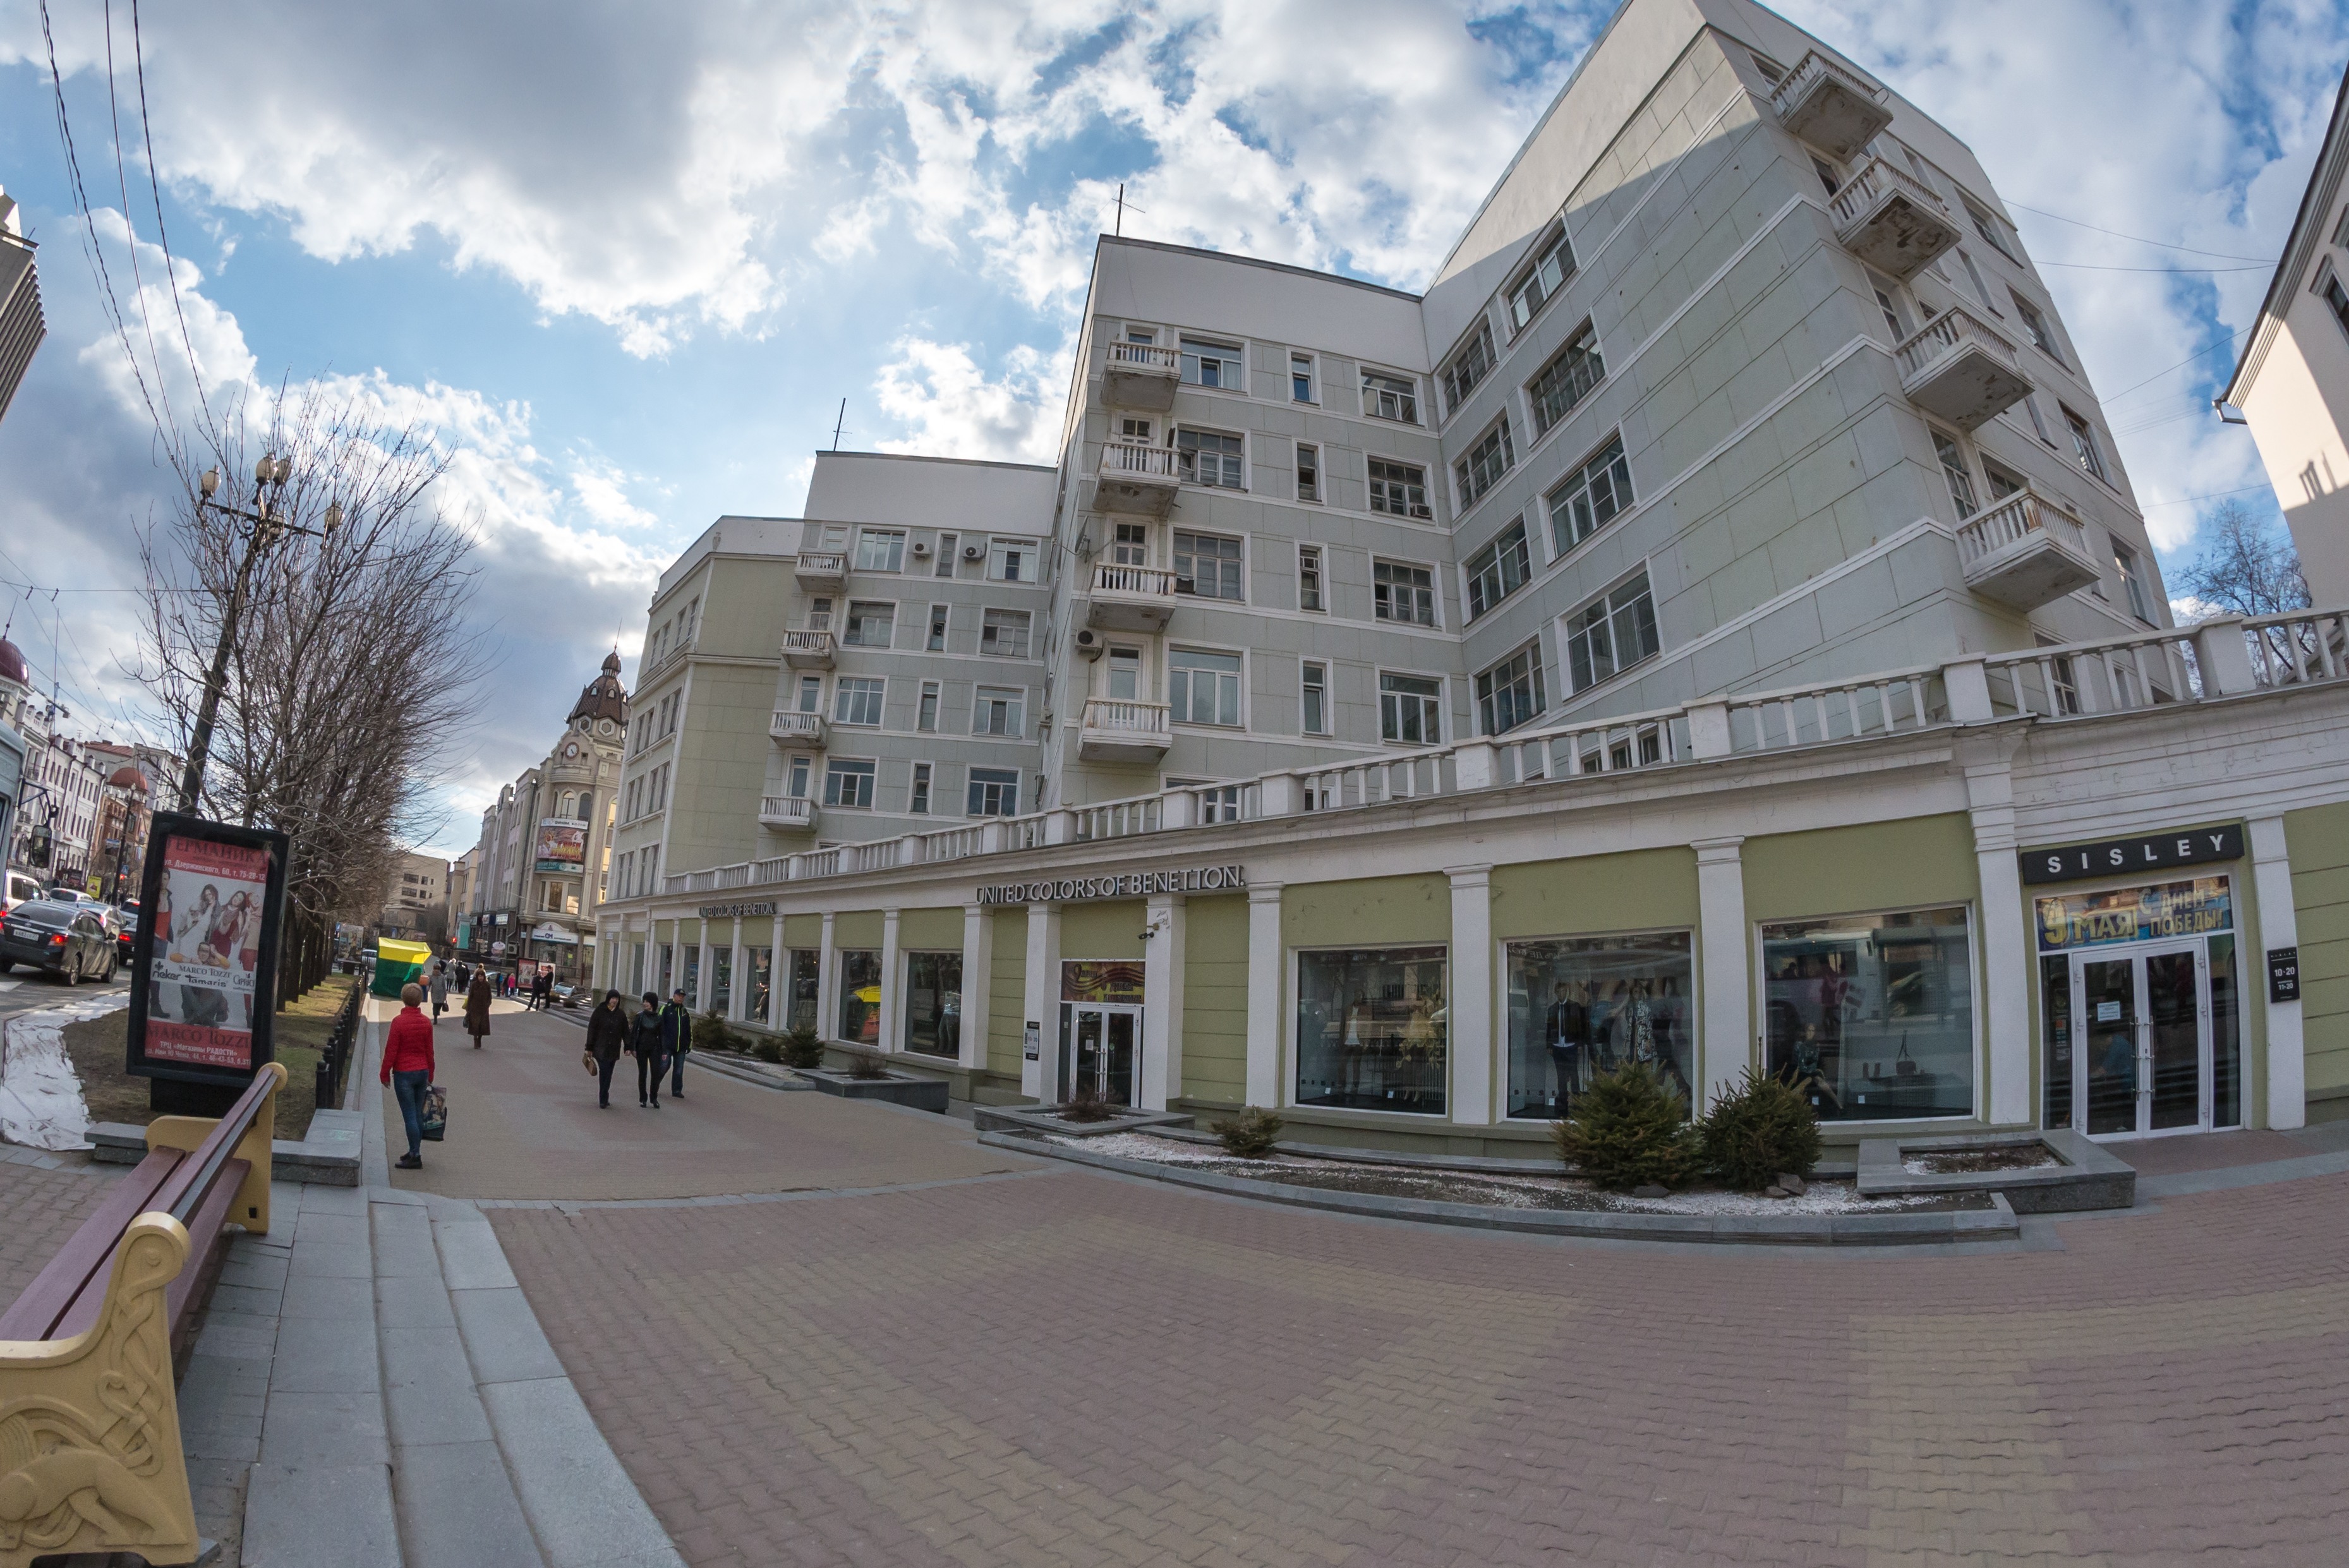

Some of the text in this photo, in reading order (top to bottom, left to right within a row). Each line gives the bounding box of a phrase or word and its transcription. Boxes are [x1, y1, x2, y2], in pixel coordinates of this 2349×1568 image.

[2048, 835, 2223, 873] SISLEY
[975, 884, 1025, 905] UNITED
[1030, 878, 1096, 902] COLORS
[1101, 874, 1125, 896] OF
[715, 905, 734, 917] COLORS
[735, 904, 744, 915] OF
[2042, 897, 2135, 944] 9 МАЯ
[2150, 907, 2223, 936] ПОБЕДЫ!
[152, 968, 181, 980] rieker
[185, 974, 226, 987] Tamaris
[179, 964, 207, 975] MARCO
[147, 1025, 202, 1042] MARCO
